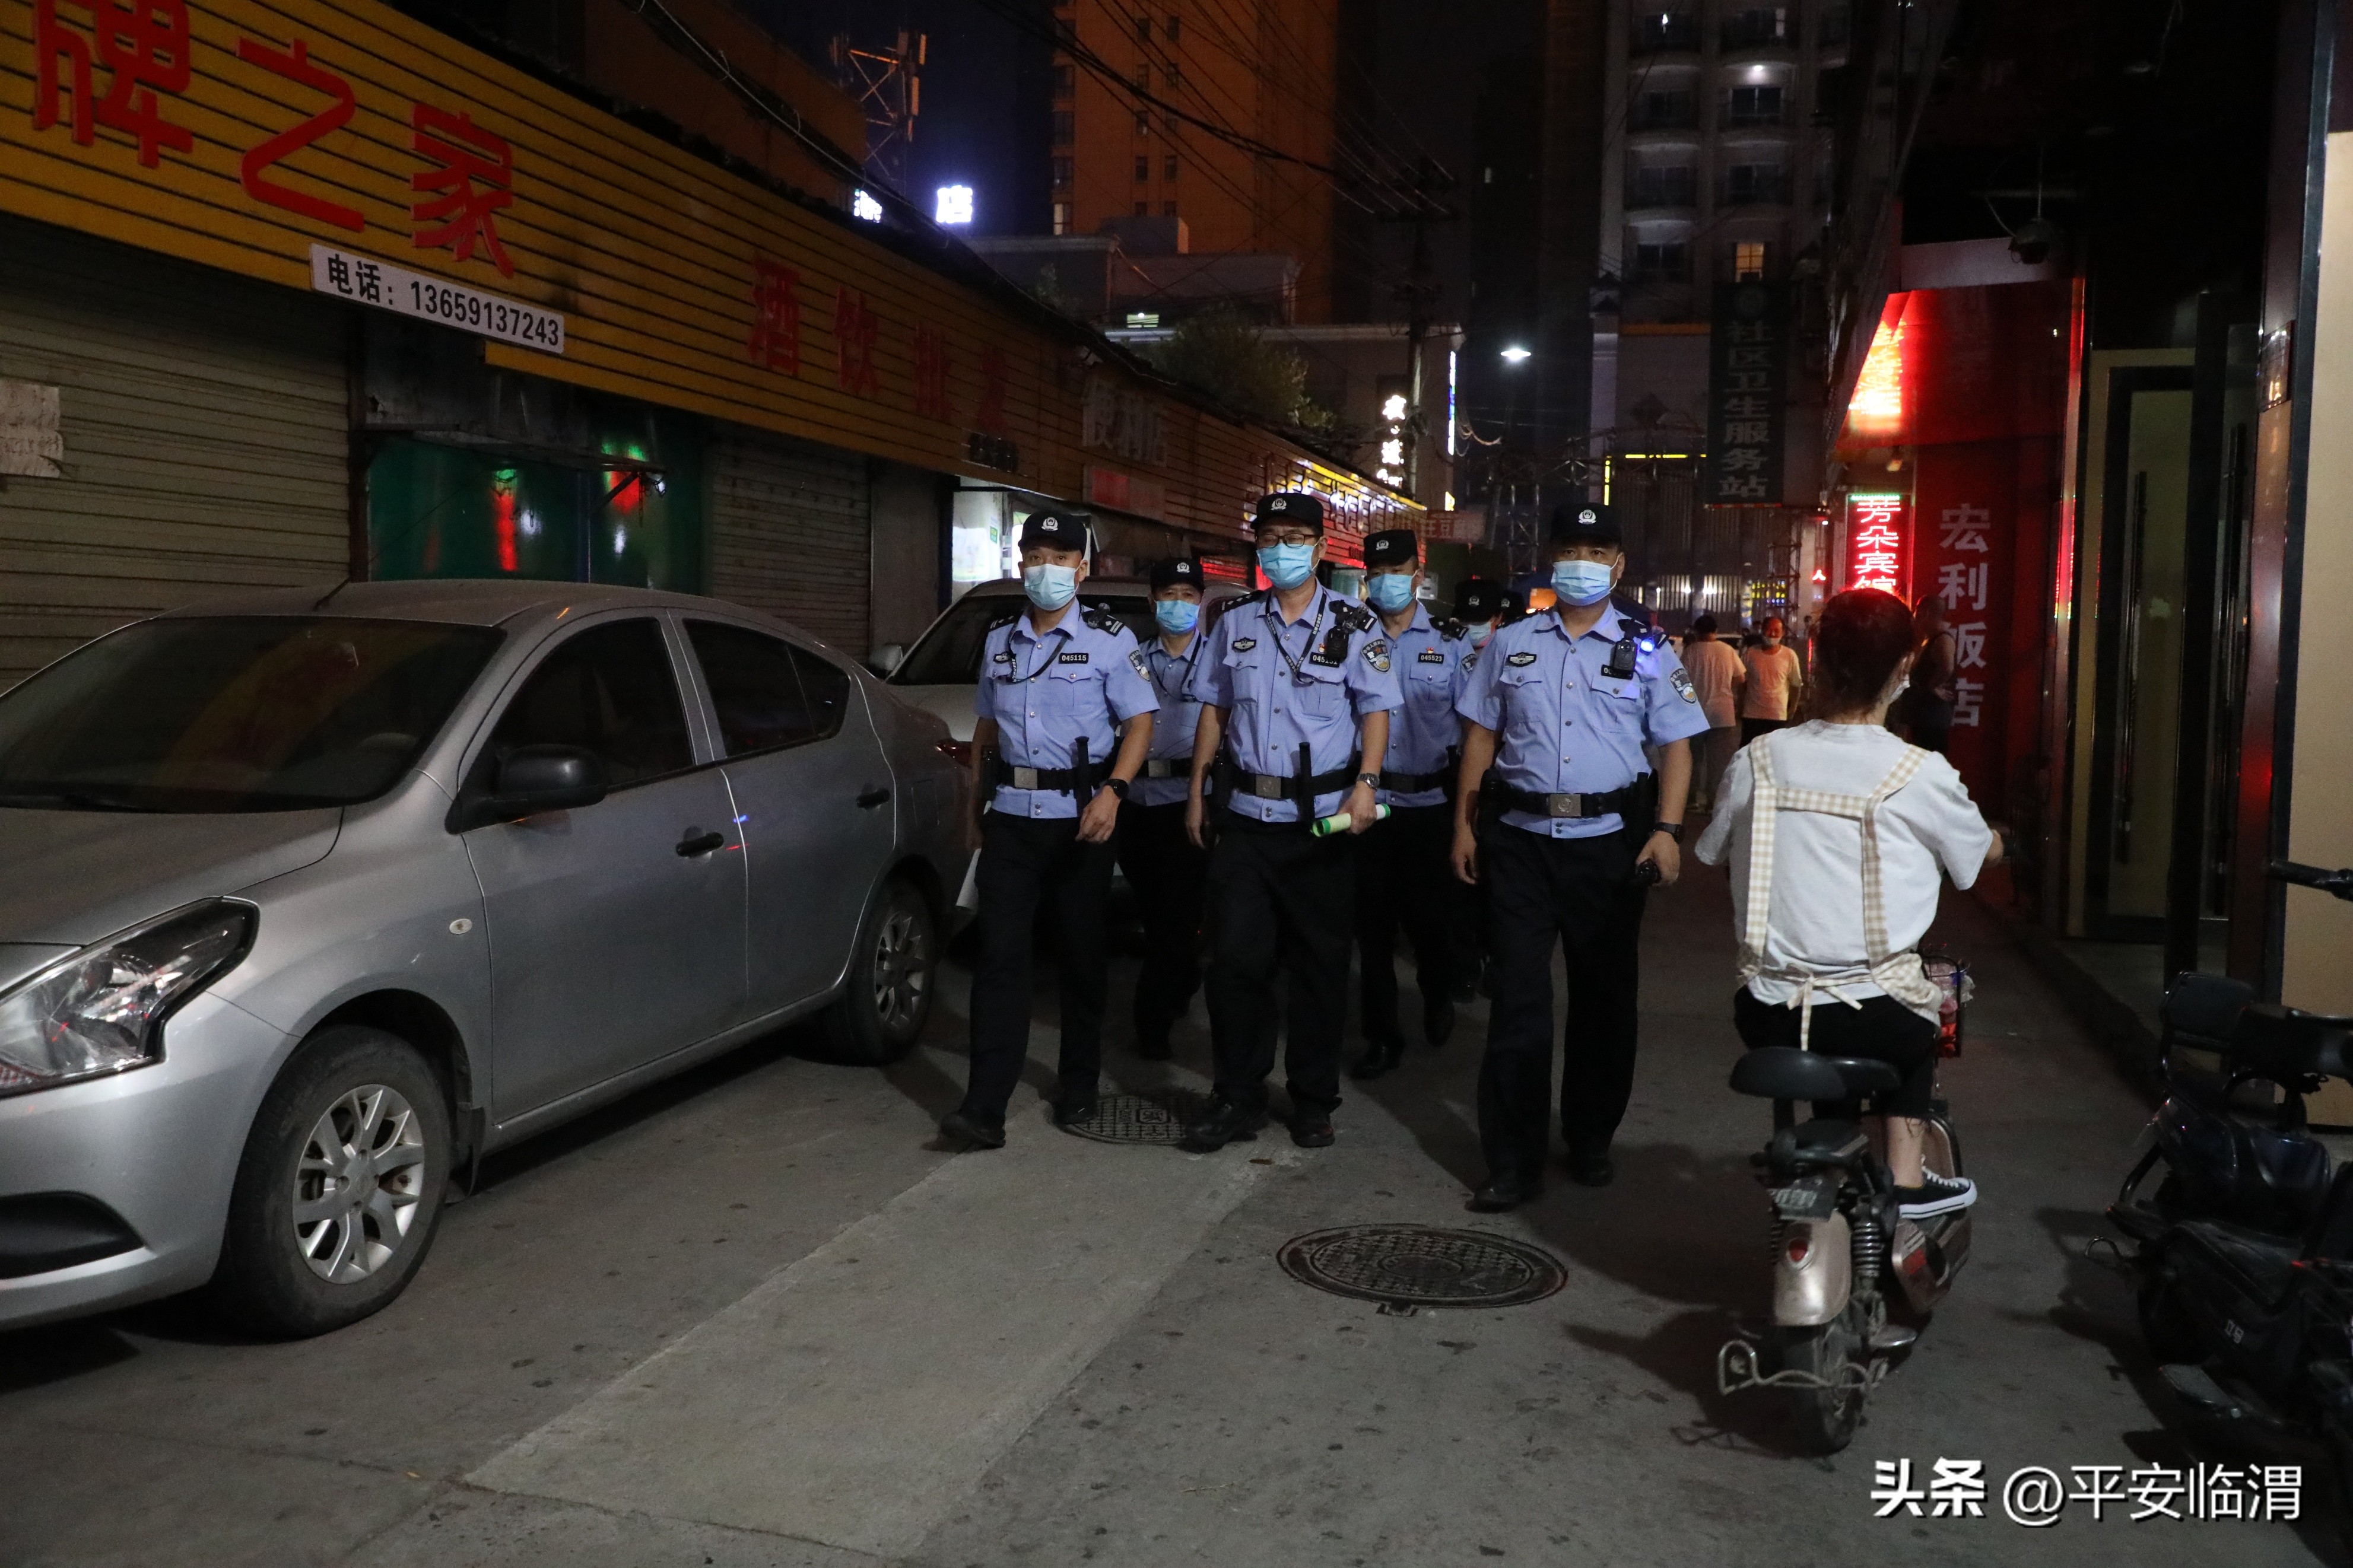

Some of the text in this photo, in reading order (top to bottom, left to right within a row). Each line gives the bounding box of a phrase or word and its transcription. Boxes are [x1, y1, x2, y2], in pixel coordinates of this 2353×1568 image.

[1719, 321, 1774, 498] 社区卫生服务站
